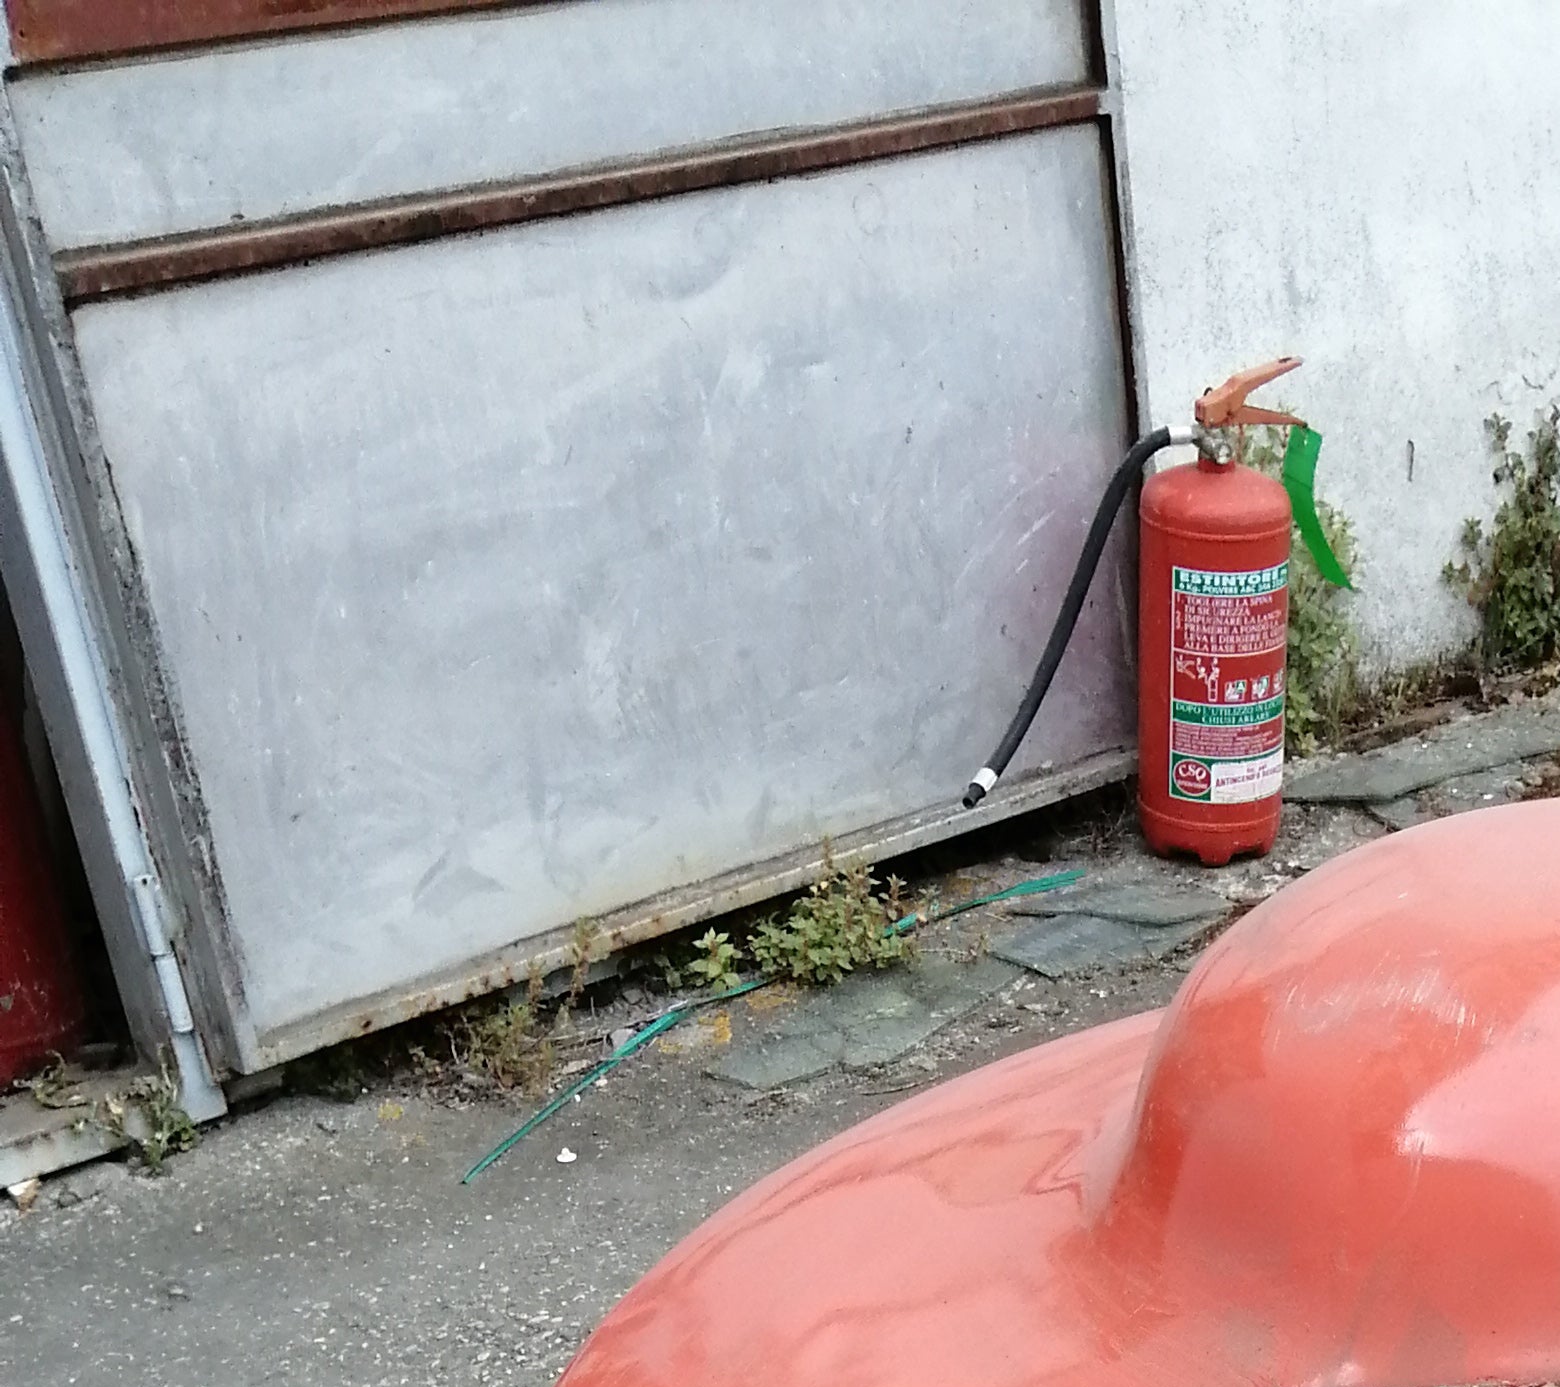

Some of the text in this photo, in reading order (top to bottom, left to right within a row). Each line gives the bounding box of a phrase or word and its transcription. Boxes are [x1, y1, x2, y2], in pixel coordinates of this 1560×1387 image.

[1186, 595, 1233, 607] TOGLIERE
[1235, 597, 1249, 607] LA
[1184, 604, 1251, 616] DI SICUREZZA
[1184, 641, 1209, 652] ALLA
